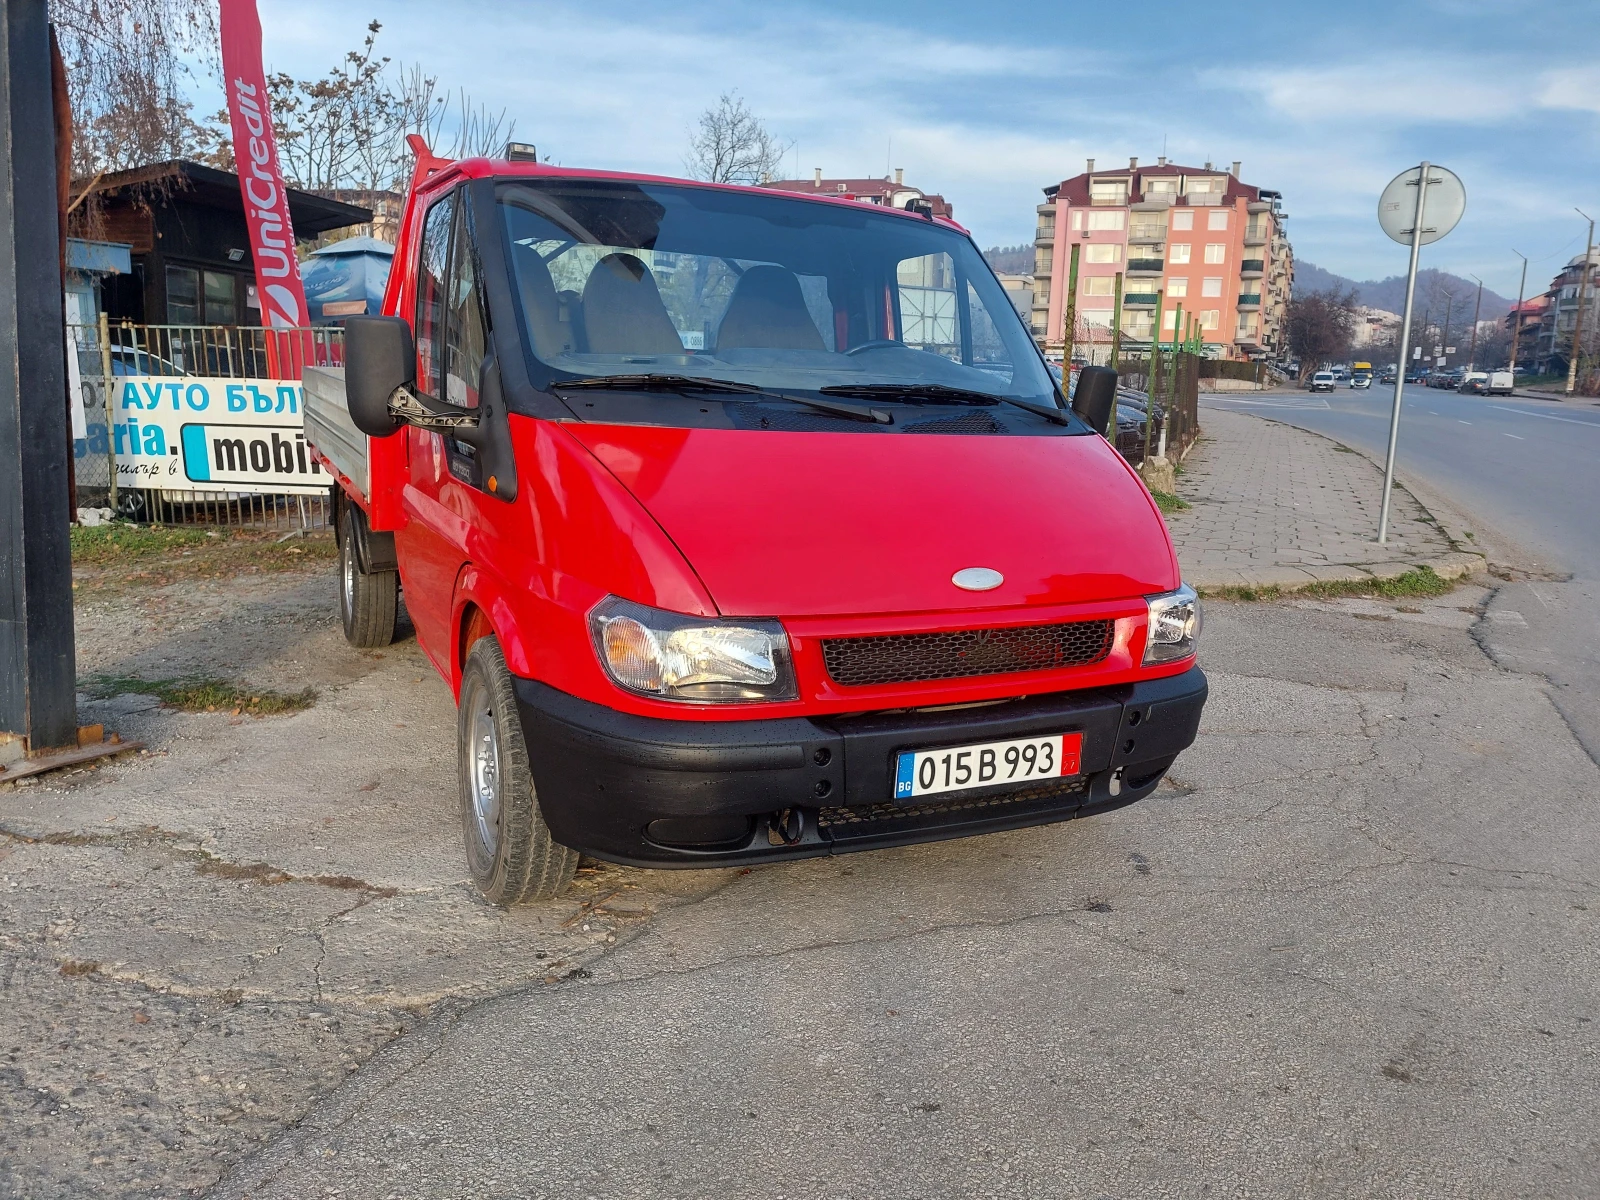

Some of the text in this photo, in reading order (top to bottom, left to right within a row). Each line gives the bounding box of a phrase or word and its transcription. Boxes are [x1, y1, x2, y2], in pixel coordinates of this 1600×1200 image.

[234, 77, 290, 278] UniCredit
[121, 382, 210, 411] АУТО
[213, 432, 331, 475] mobi
[898, 781, 911, 793] BG
